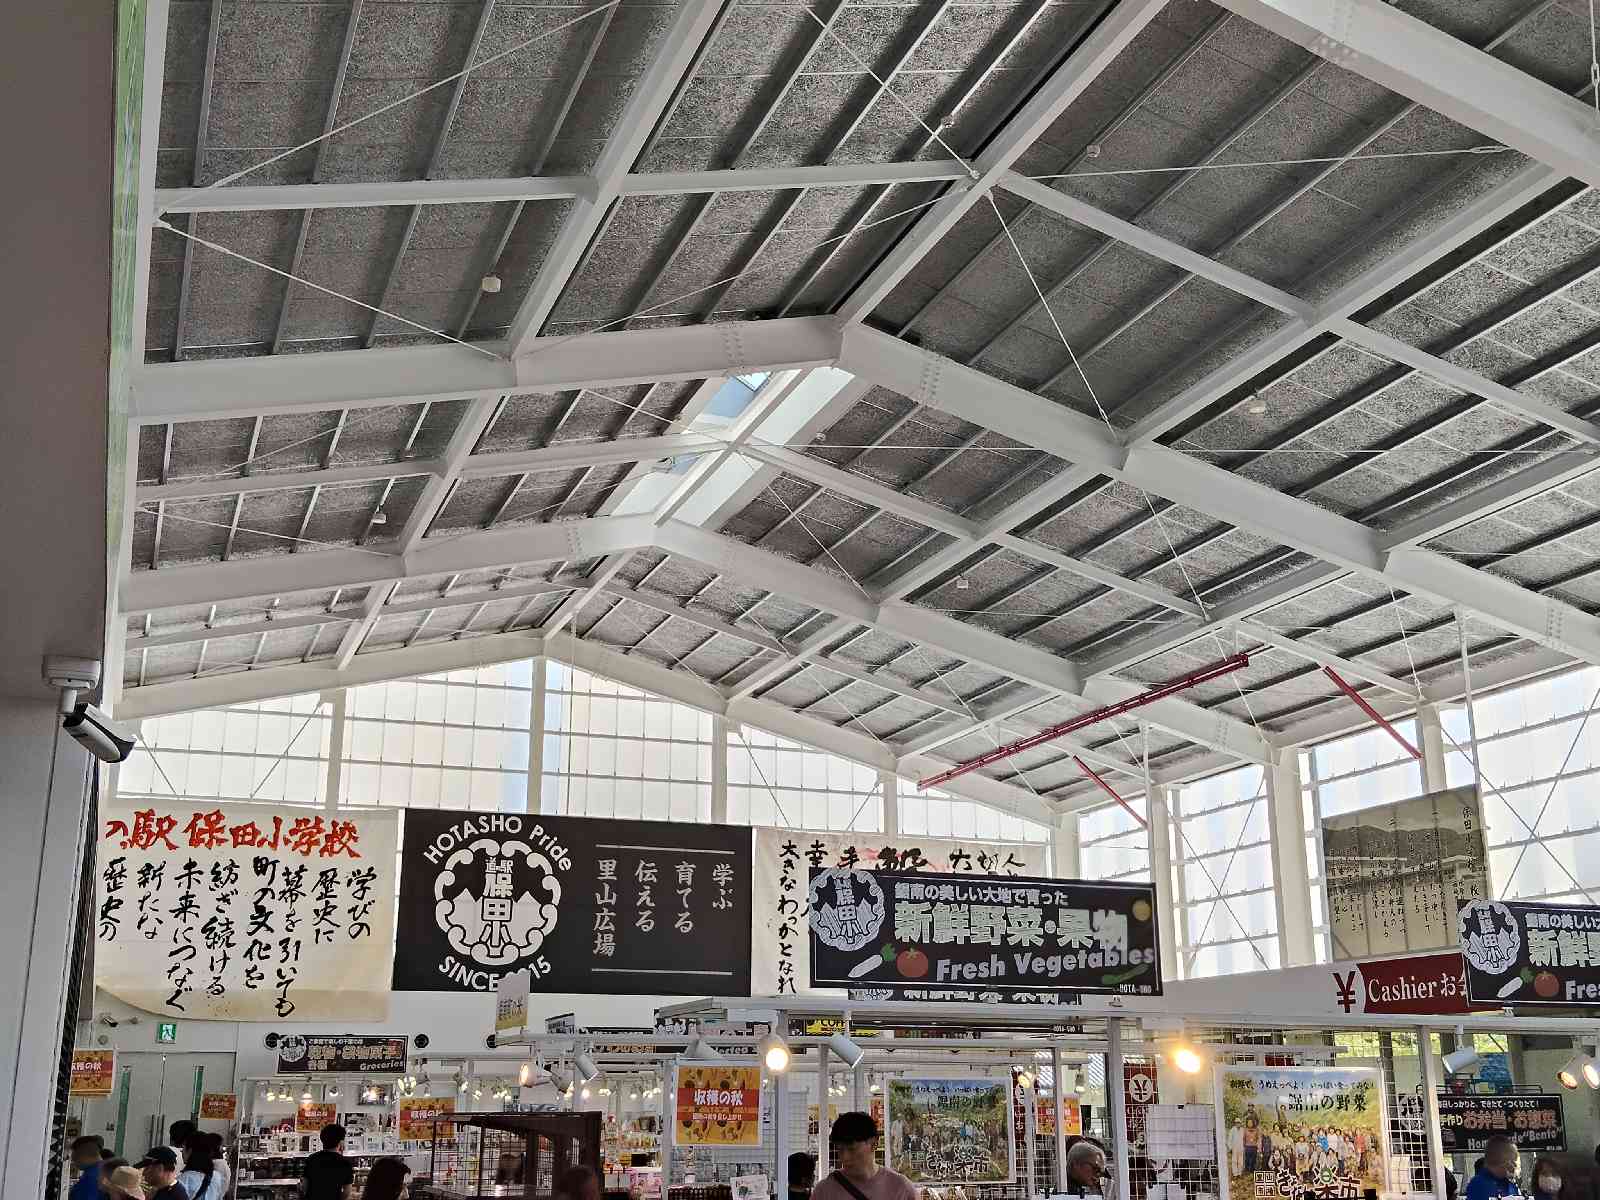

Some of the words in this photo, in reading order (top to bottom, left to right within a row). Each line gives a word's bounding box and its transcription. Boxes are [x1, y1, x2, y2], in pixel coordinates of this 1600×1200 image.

[423, 816, 522, 864] HOTASHO
[529, 824, 572, 872] Pride
[310, 867, 341, 944] 歴史に
[592, 858, 618, 958] 里山広場
[634, 858, 659, 933] 伝える
[674, 860, 697, 934] 育てる
[711, 862, 735, 911] 学ぶ
[894, 900, 1129, 952] 新鮮野菜・果物
[438, 955, 500, 993] SINCE
[936, 952, 1007, 982] Fresh
[1013, 946, 1155, 979] Vegetables
[1368, 975, 1438, 1003] Cashier
[1565, 980, 1600, 1001] Fre
